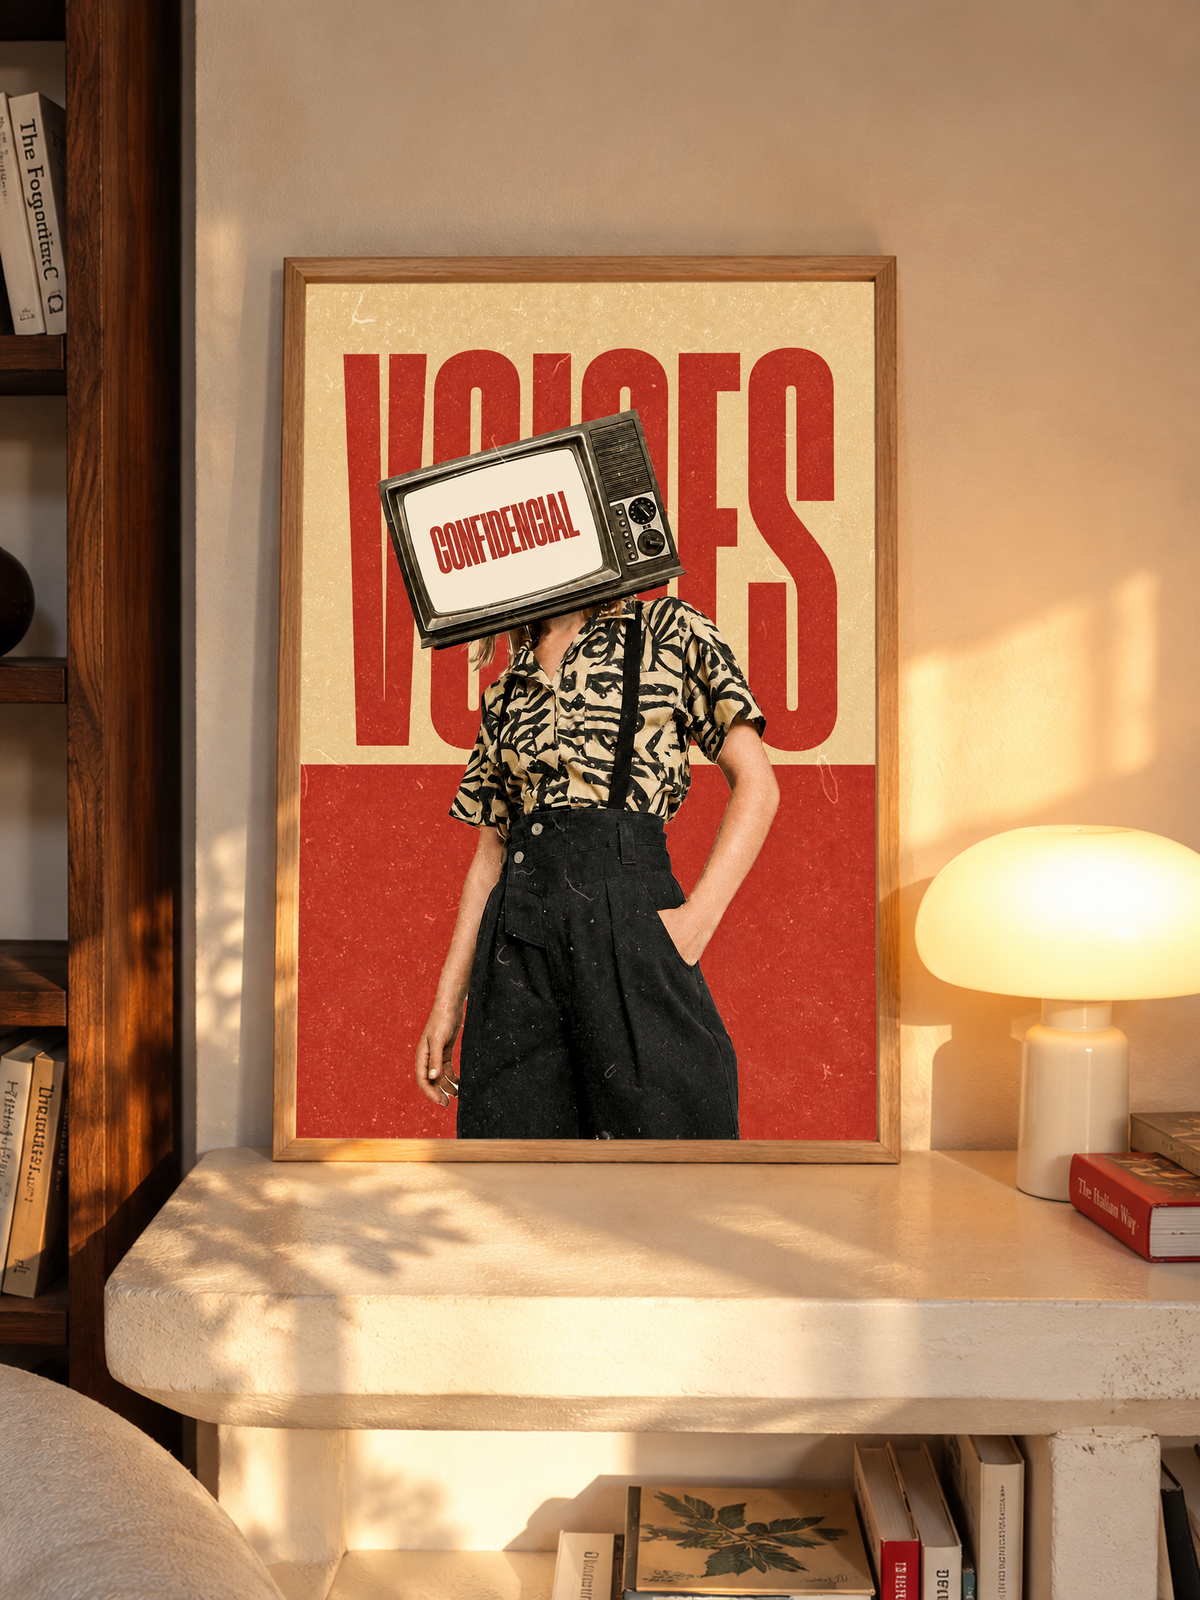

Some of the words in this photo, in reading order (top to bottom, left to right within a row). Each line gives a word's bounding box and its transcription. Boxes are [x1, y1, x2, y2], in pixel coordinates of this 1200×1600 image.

[20, 118, 38, 160] The
[344, 348, 838, 751] VES
[429, 490, 581, 574] CONFIDENCIAL
[1077, 1177, 1092, 1200] The
[1093, 1187, 1119, 1219] Italian
